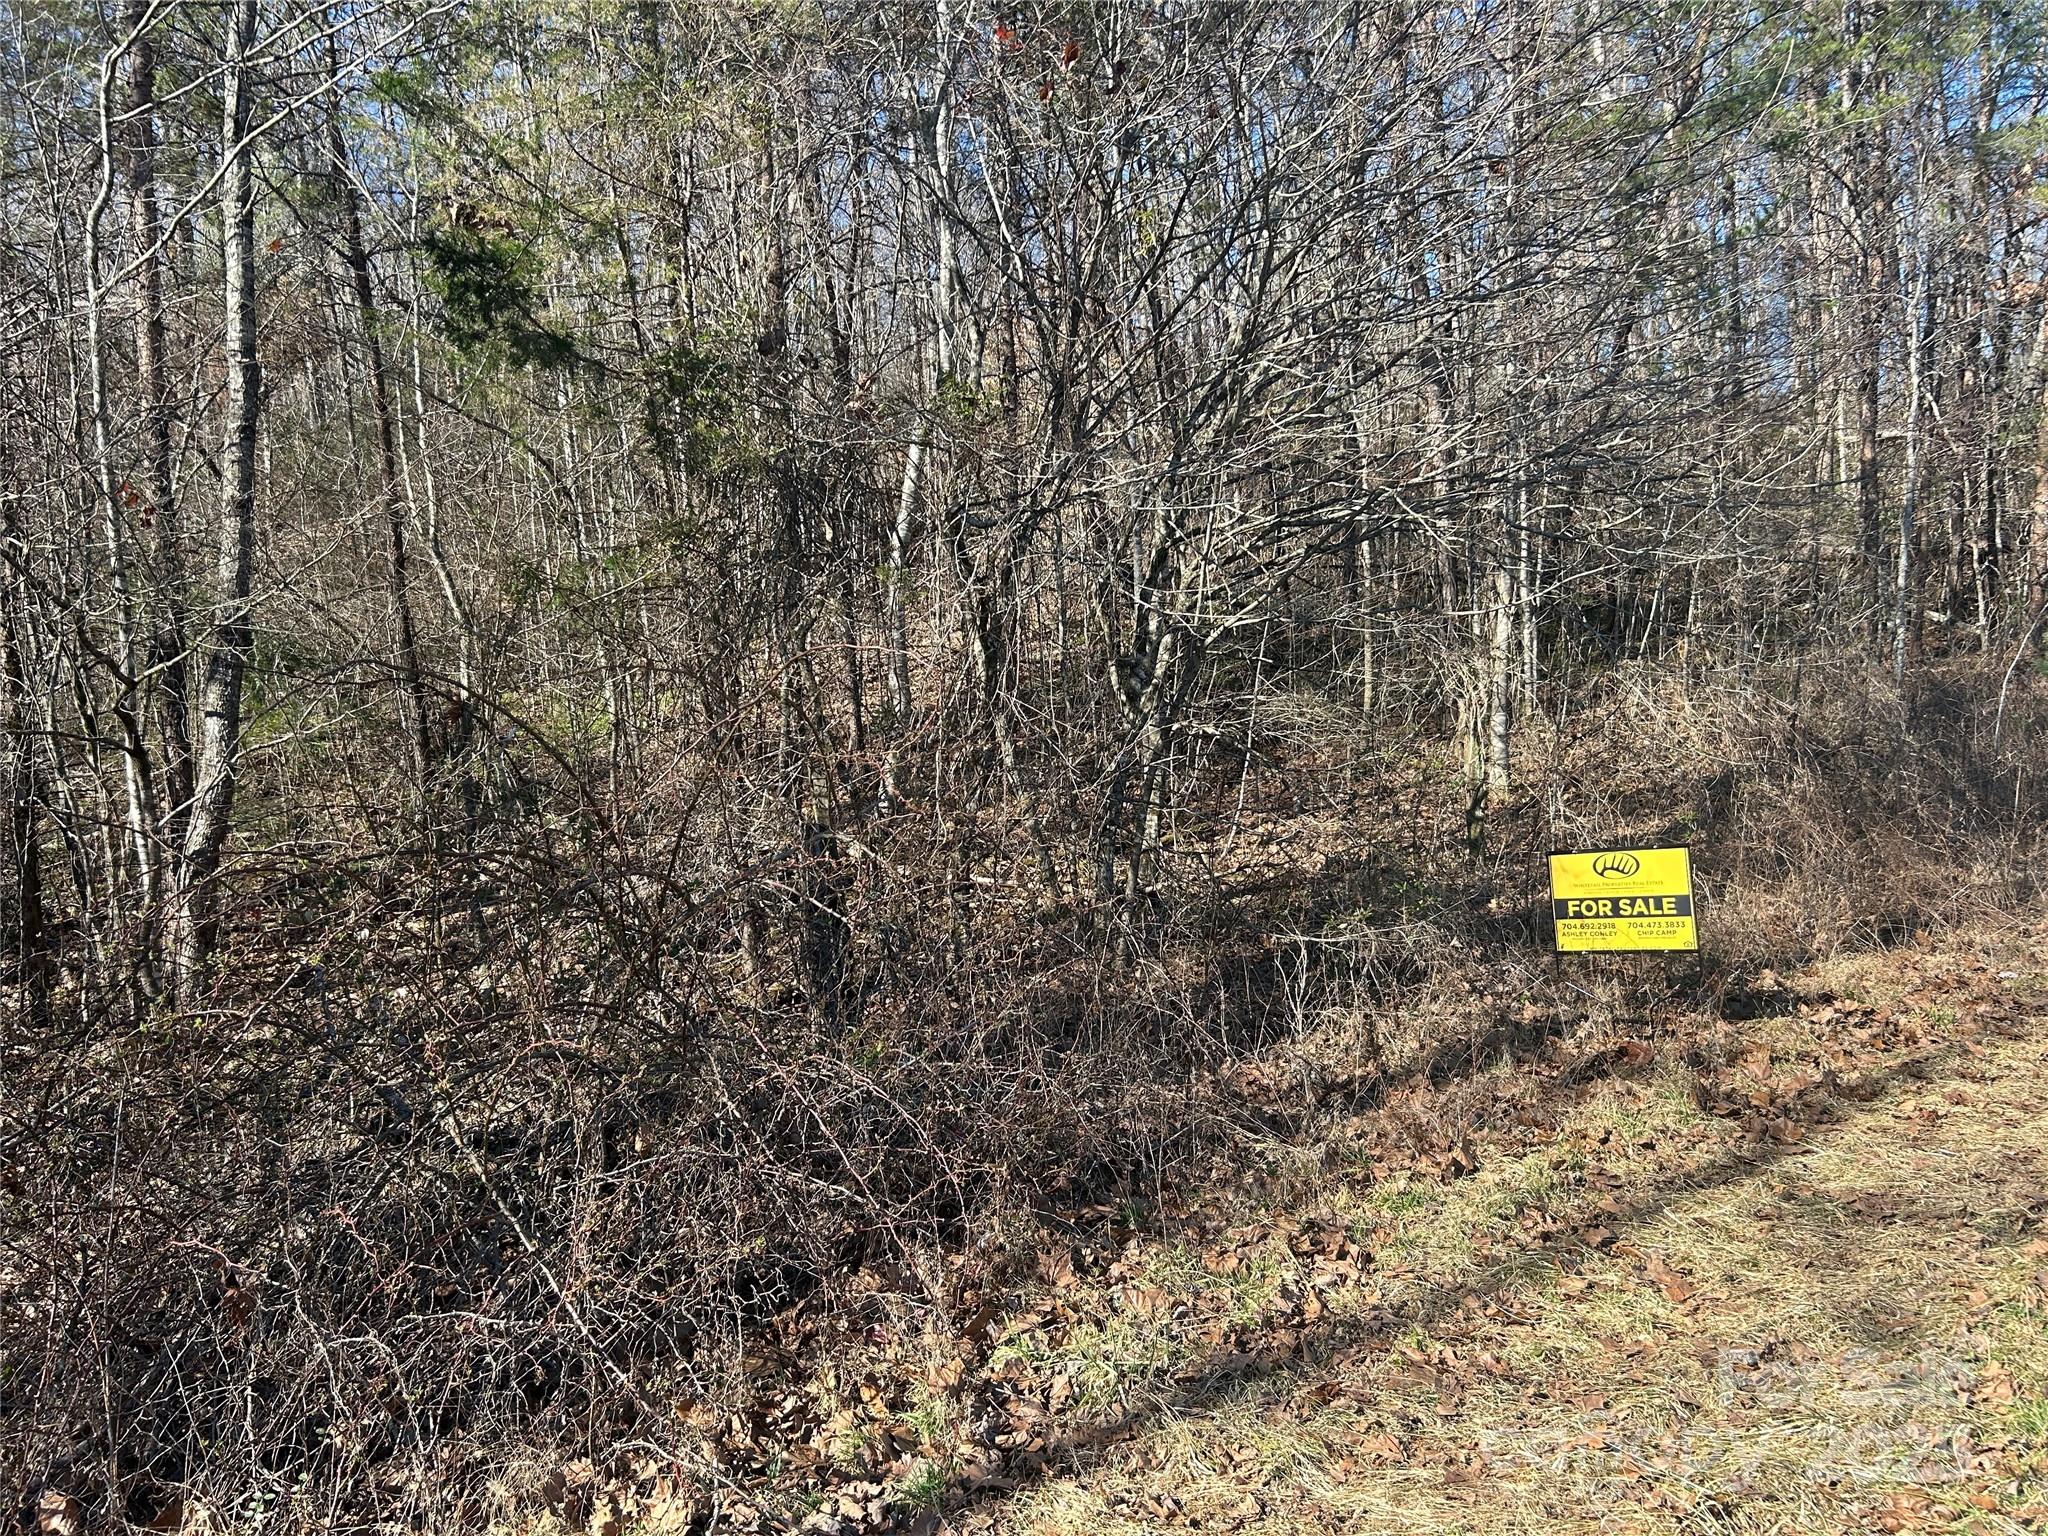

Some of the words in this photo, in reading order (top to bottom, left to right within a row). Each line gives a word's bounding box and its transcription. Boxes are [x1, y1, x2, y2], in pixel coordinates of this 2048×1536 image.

[1567, 899, 1613, 917] FOR
[1619, 897, 1677, 916] SALE
[1628, 921, 1686, 929] 704.473.3833
